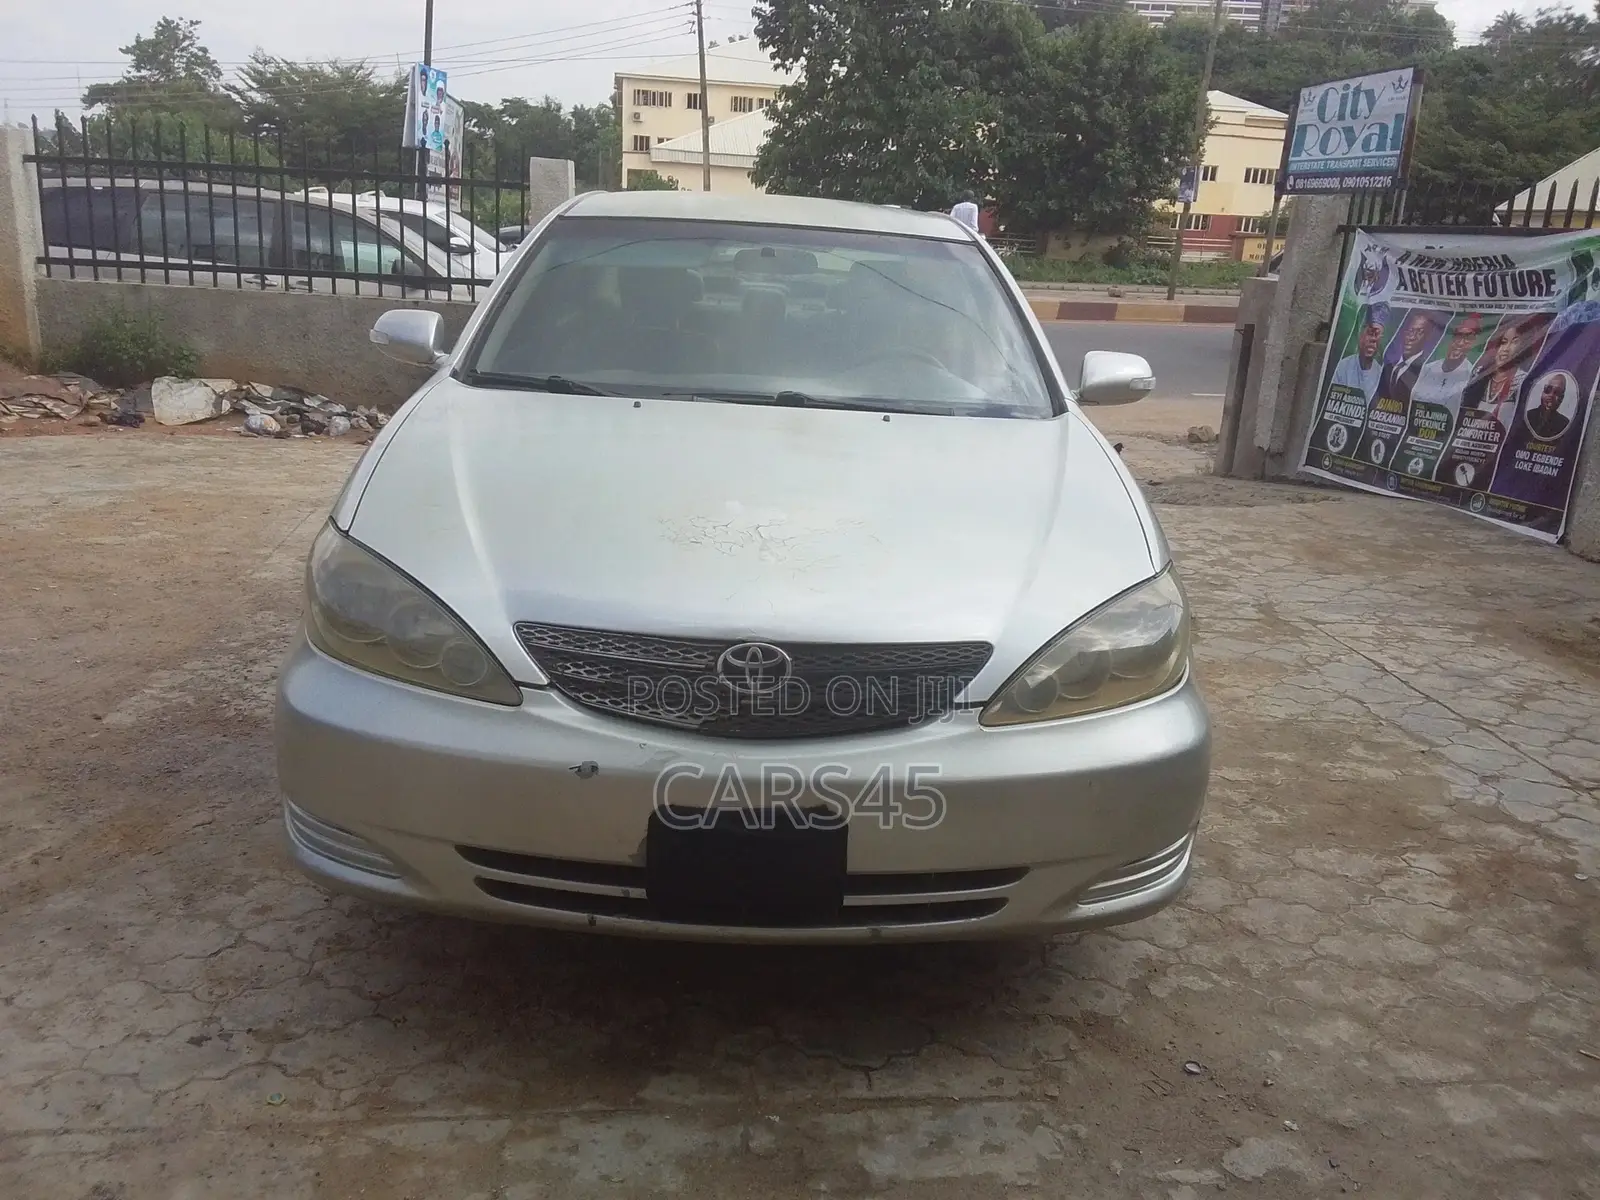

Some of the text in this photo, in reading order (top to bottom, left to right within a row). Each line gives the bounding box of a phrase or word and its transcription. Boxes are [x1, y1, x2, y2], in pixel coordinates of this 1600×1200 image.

[1317, 80, 1386, 123] City
[1291, 113, 1406, 157] Royal
[1326, 159, 1362, 169] TRANSPORT
[1396, 266, 1408, 291] A
[1408, 267, 1468, 297] BETTER
[1330, 391, 1343, 400] SEYI
[1326, 399, 1366, 419] MAKINDE
[1419, 428, 1437, 439] DON
[1457, 427, 1501, 443] COMFORTER
[1515, 449, 1530, 461] OMO
[1515, 460, 1559, 477] LOKE IBADAN
